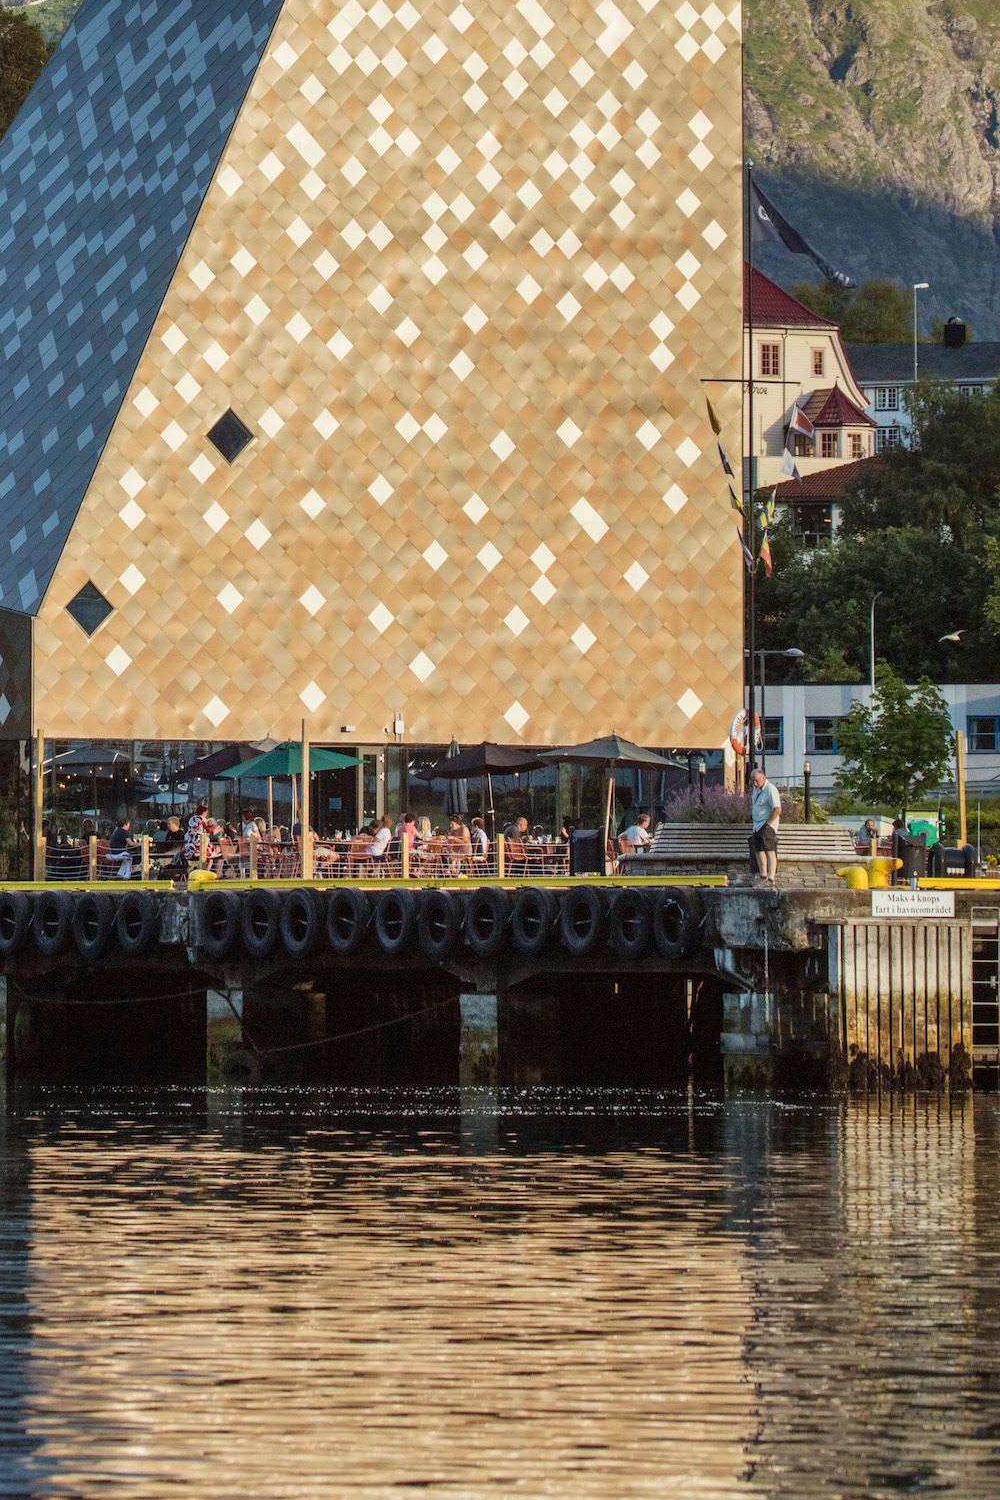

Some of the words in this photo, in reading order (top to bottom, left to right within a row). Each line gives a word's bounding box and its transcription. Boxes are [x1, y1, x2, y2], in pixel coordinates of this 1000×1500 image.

[887, 894, 909, 903] Maks
[910, 894, 916, 903] 4
[917, 894, 940, 905] knops
[875, 906, 890, 914] fart
